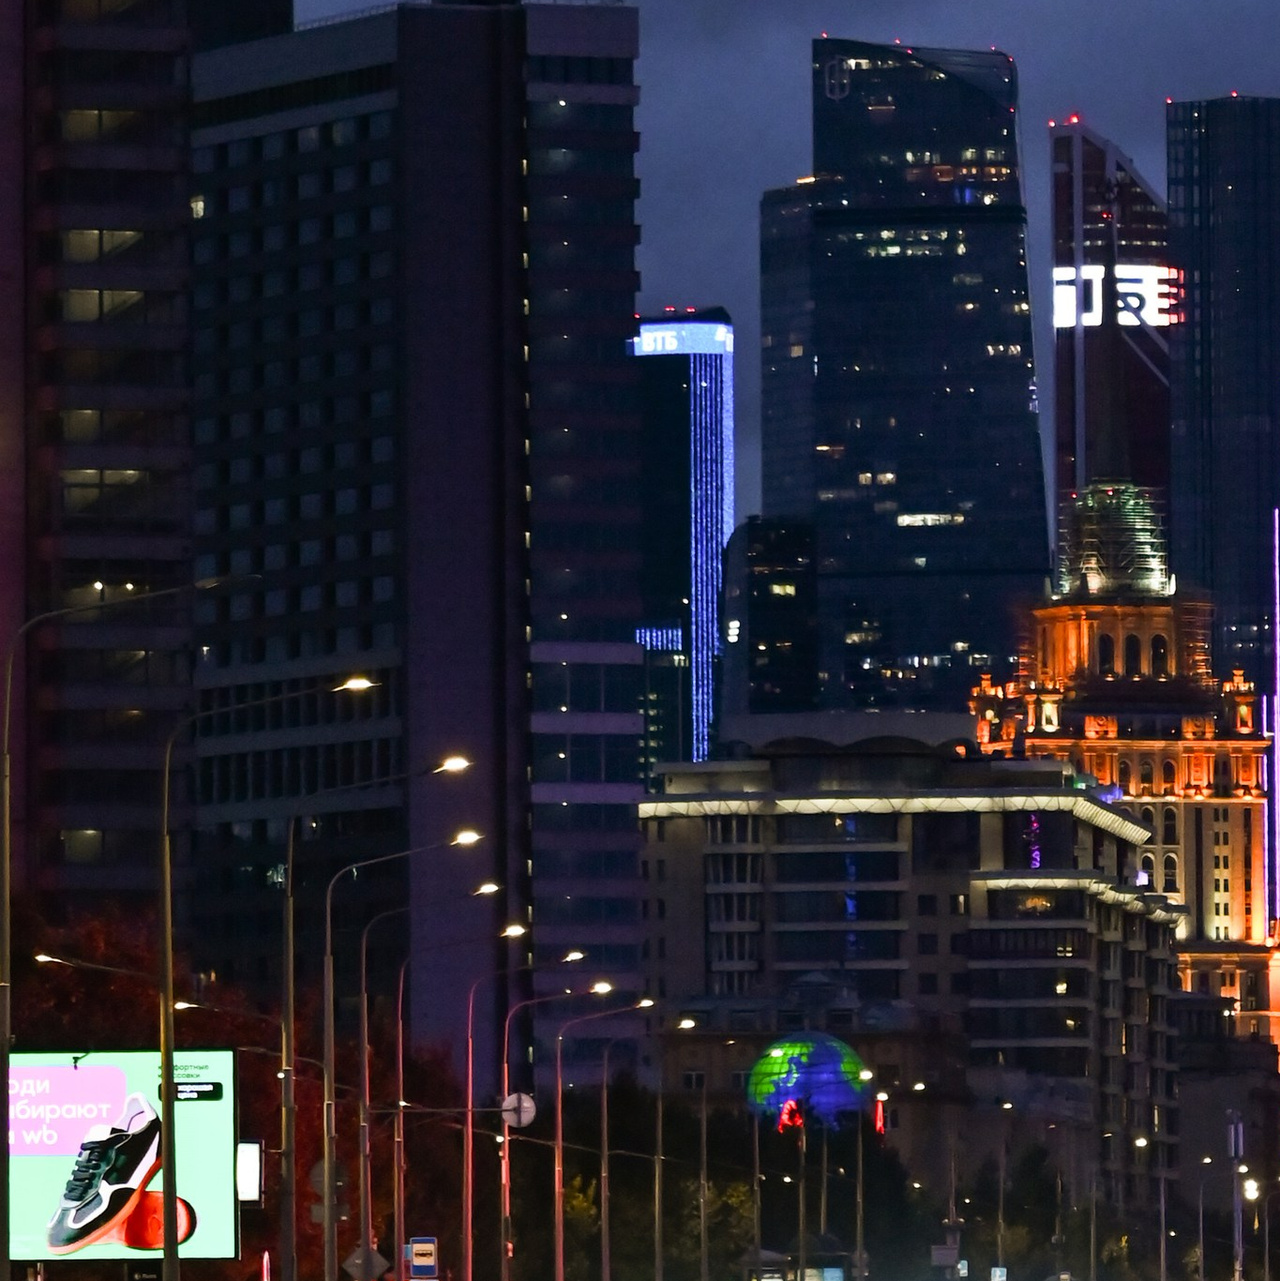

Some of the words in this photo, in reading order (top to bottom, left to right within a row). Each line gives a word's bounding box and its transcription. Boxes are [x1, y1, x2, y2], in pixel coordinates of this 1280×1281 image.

[642, 331, 678, 352] ВТБ
[9, 1102, 111, 1123] бирают
[23, 1127, 58, 1145] wb
